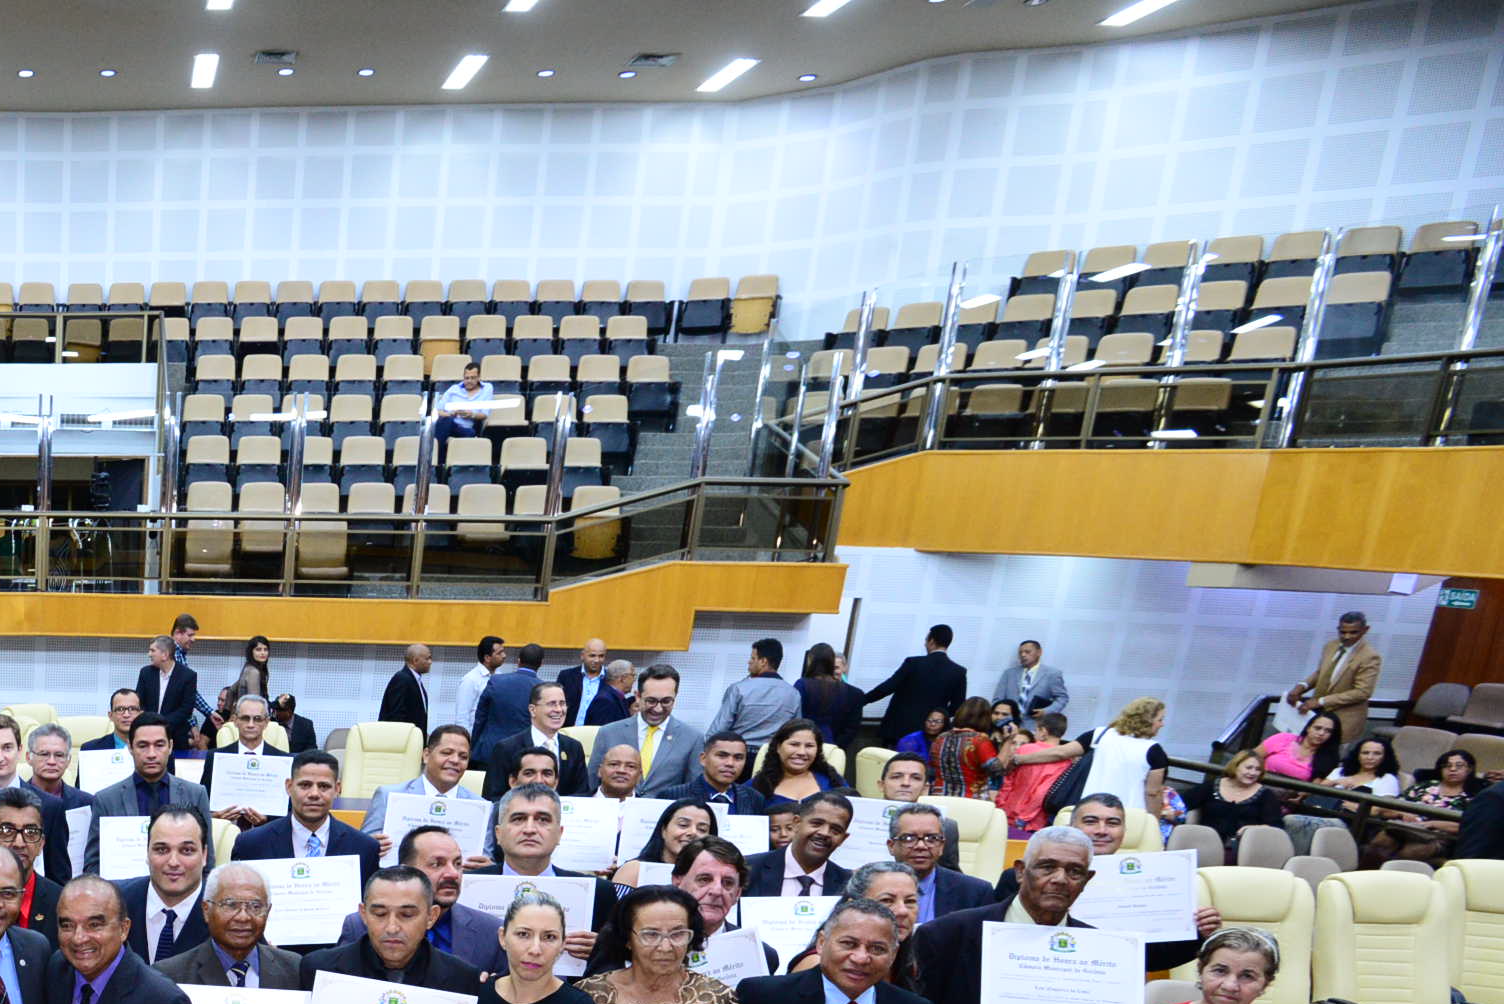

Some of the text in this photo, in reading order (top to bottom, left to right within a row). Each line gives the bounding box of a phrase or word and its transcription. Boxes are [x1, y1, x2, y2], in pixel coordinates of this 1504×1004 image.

[1009, 953, 1039, 962] Diploma
[1054, 956, 1076, 964] Honra
[1091, 959, 1116, 968] Mérito
